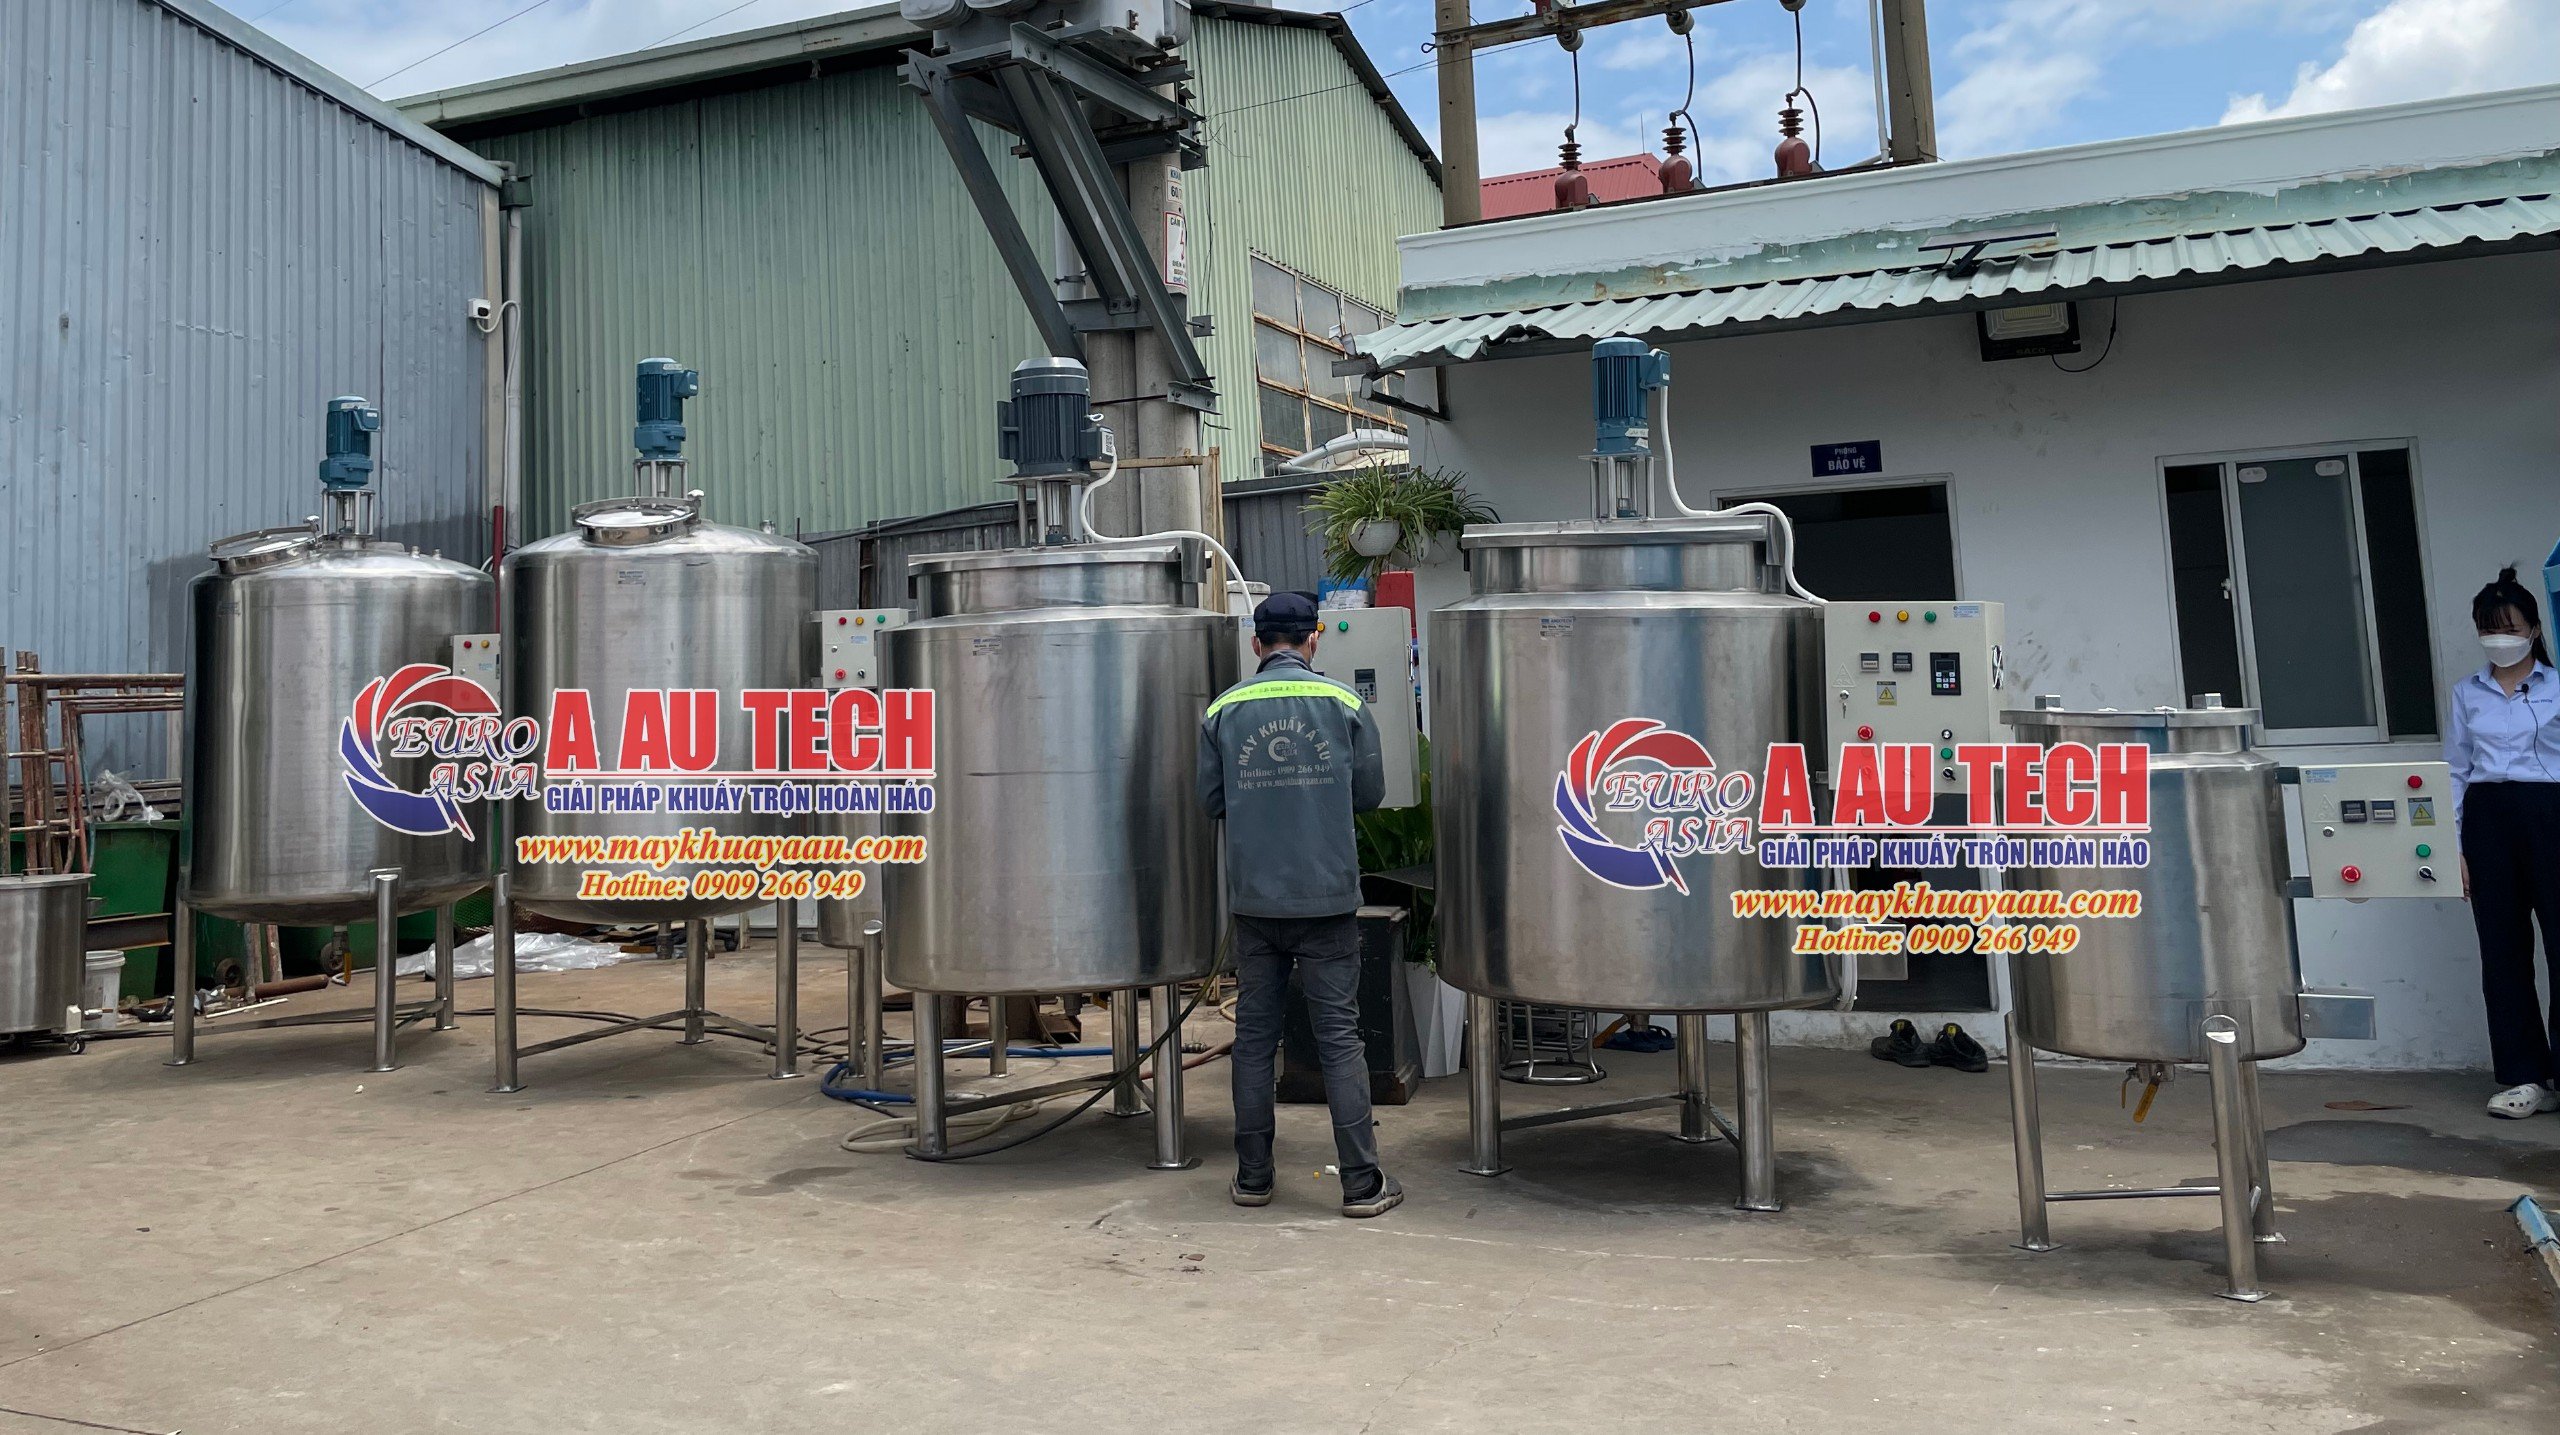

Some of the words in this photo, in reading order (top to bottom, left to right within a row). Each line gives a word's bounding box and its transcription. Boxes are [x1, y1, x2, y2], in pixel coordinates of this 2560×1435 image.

[1828, 456, 1850, 471] BẢO
[1853, 455, 1866, 471] VỆ
[1258, 715, 1306, 738] KHUẤY
[1240, 767, 1276, 778] Hotline:
[1297, 764, 1313, 774] 266
[1314, 763, 1330, 773] 949
